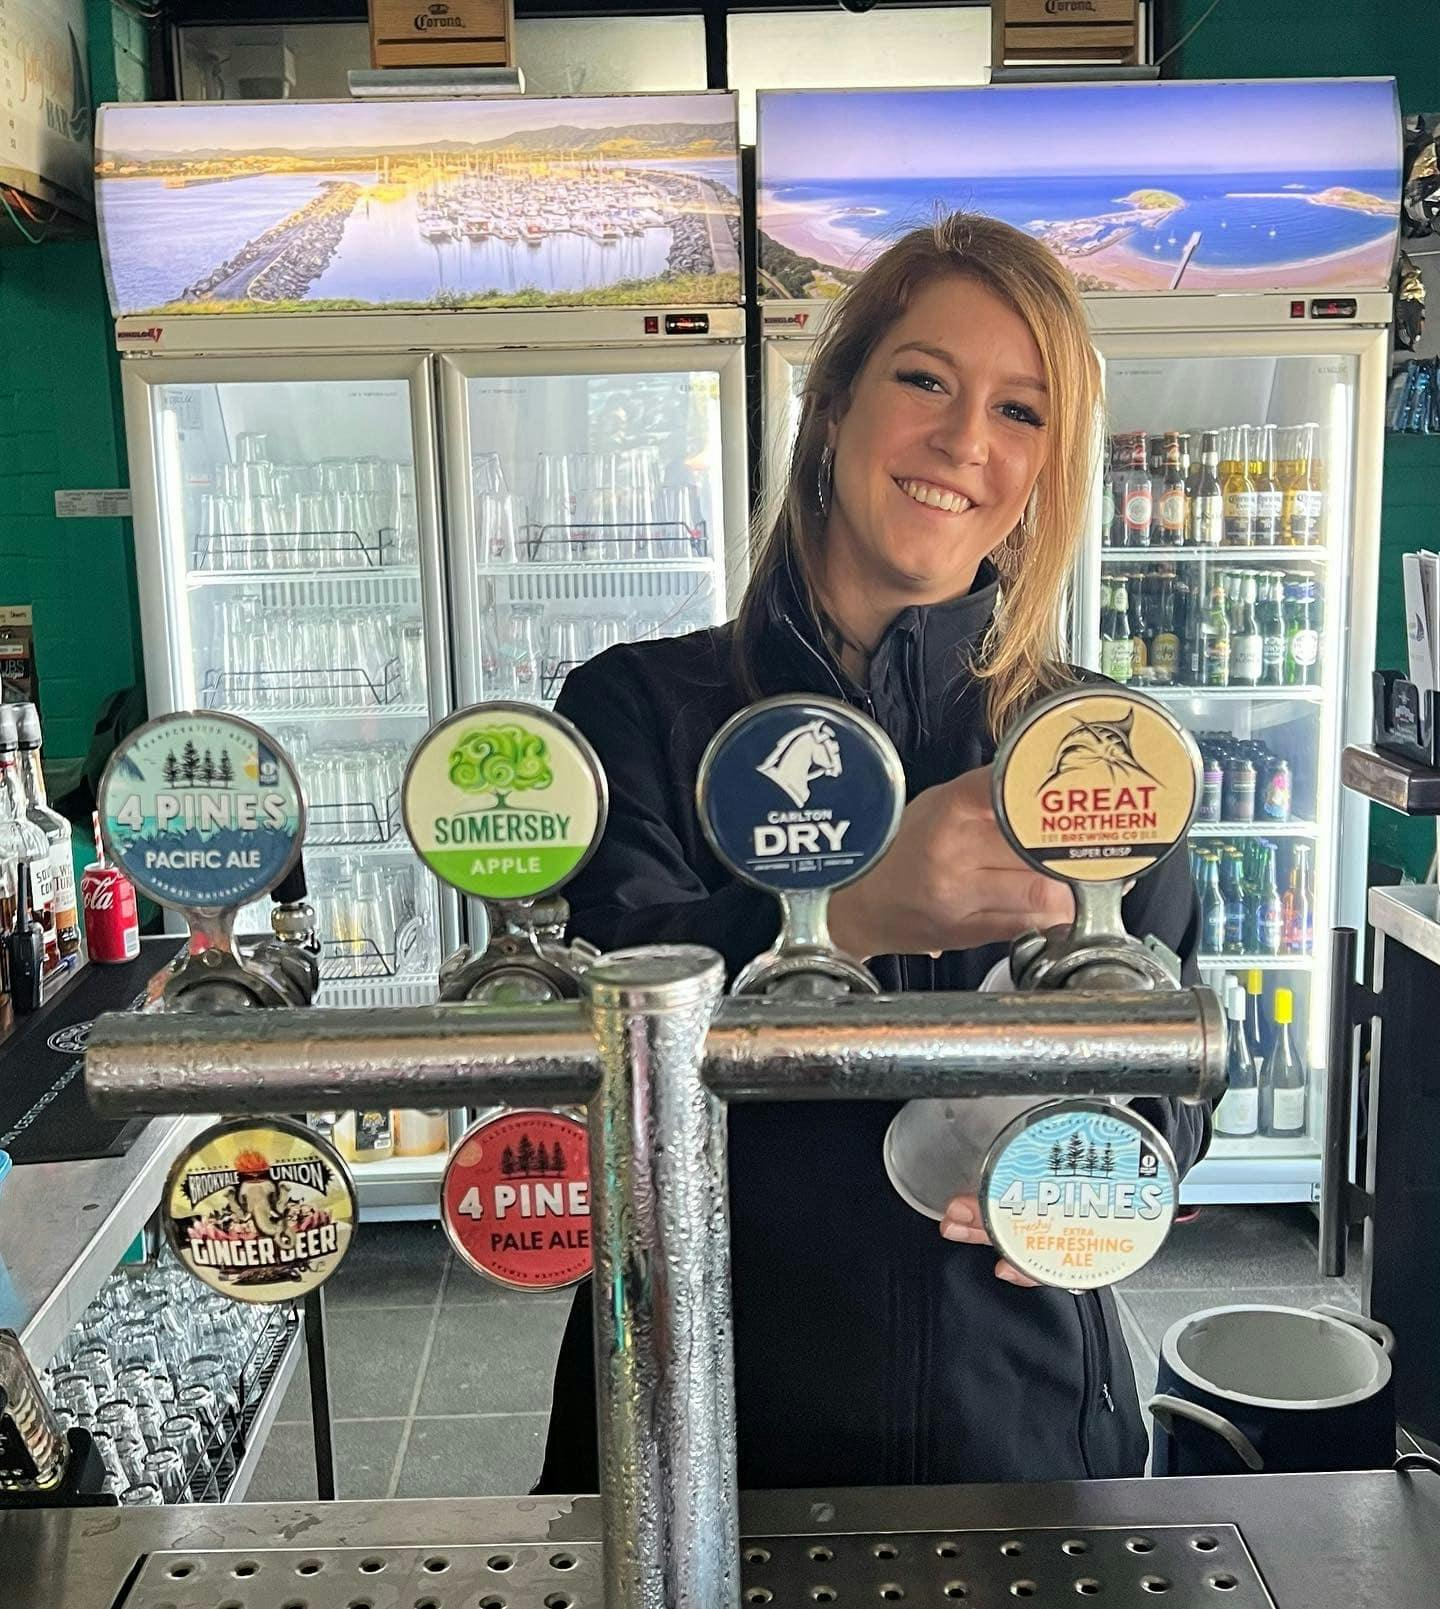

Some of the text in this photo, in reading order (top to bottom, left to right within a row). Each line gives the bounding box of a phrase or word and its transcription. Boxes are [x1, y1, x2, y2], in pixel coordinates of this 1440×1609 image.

[414, 14, 466, 32] Corona
[1041, 786, 1157, 813] GREAT
[117, 793, 288, 833] 4 PINES
[767, 809, 833, 824] CARLTON
[1042, 812, 1157, 832] NORTHERN
[435, 813, 571, 844] SOMERSBY
[754, 820, 850, 857] DRY
[1061, 831, 1119, 842] BREWING
[146, 851, 261, 869] PACIFIC ALE
[1069, 847, 1132, 858] SUPER CRISP
[470, 857, 542, 876] APPLE
[82, 876, 114, 910] ola
[188, 1162, 324, 1204] BROOKVALE UNION
[458, 1182, 591, 1220] 4 PINE
[999, 1180, 1163, 1220] 4 PINES
[491, 1229, 589, 1252] PALE ALE
[1063, 1227, 1095, 1236] EXTRA
[190, 1237, 276, 1266] GINGER
[1026, 1236, 1136, 1253] REFRESHING
[1062, 1253, 1094, 1267] ALE
